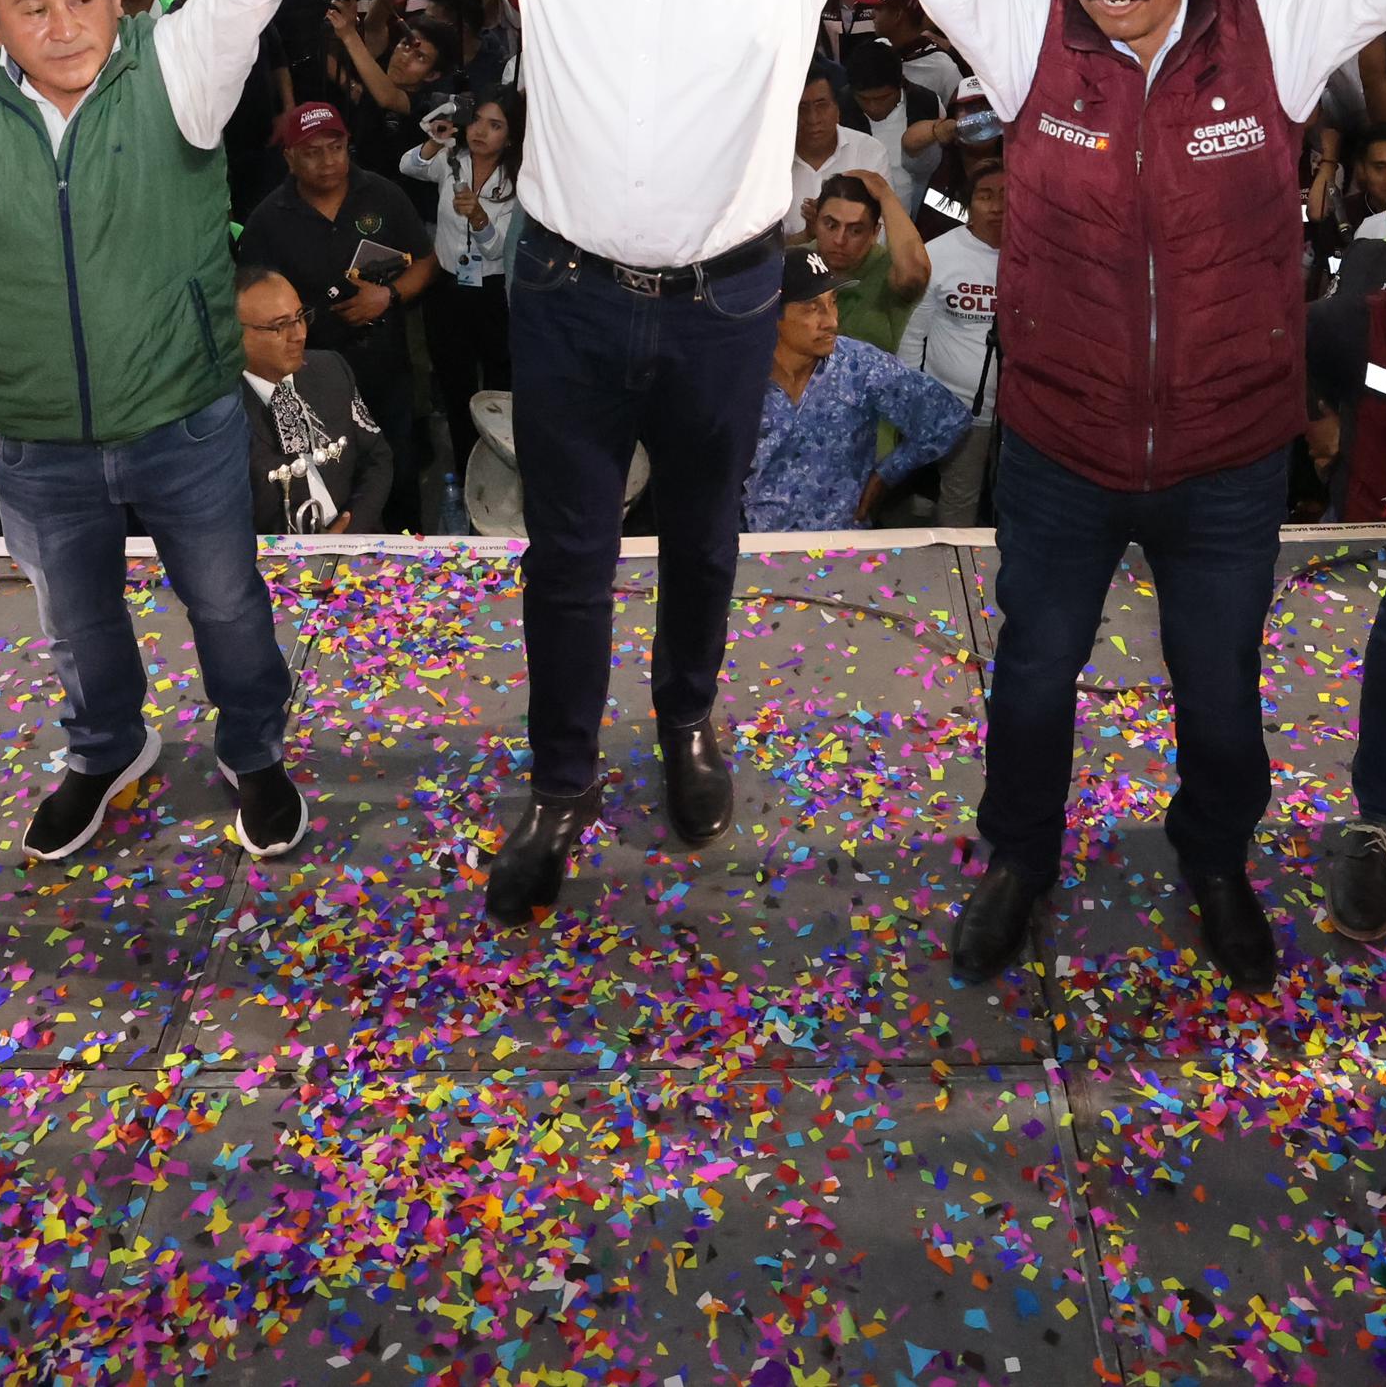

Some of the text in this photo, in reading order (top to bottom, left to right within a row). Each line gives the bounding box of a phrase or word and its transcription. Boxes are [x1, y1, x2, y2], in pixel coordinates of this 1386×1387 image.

[299, 112, 334, 125] ARMENTA
[1193, 115, 1258, 140] GERMAN
[1038, 118, 1097, 150] morena
[1186, 126, 1266, 156] COLEOTE
